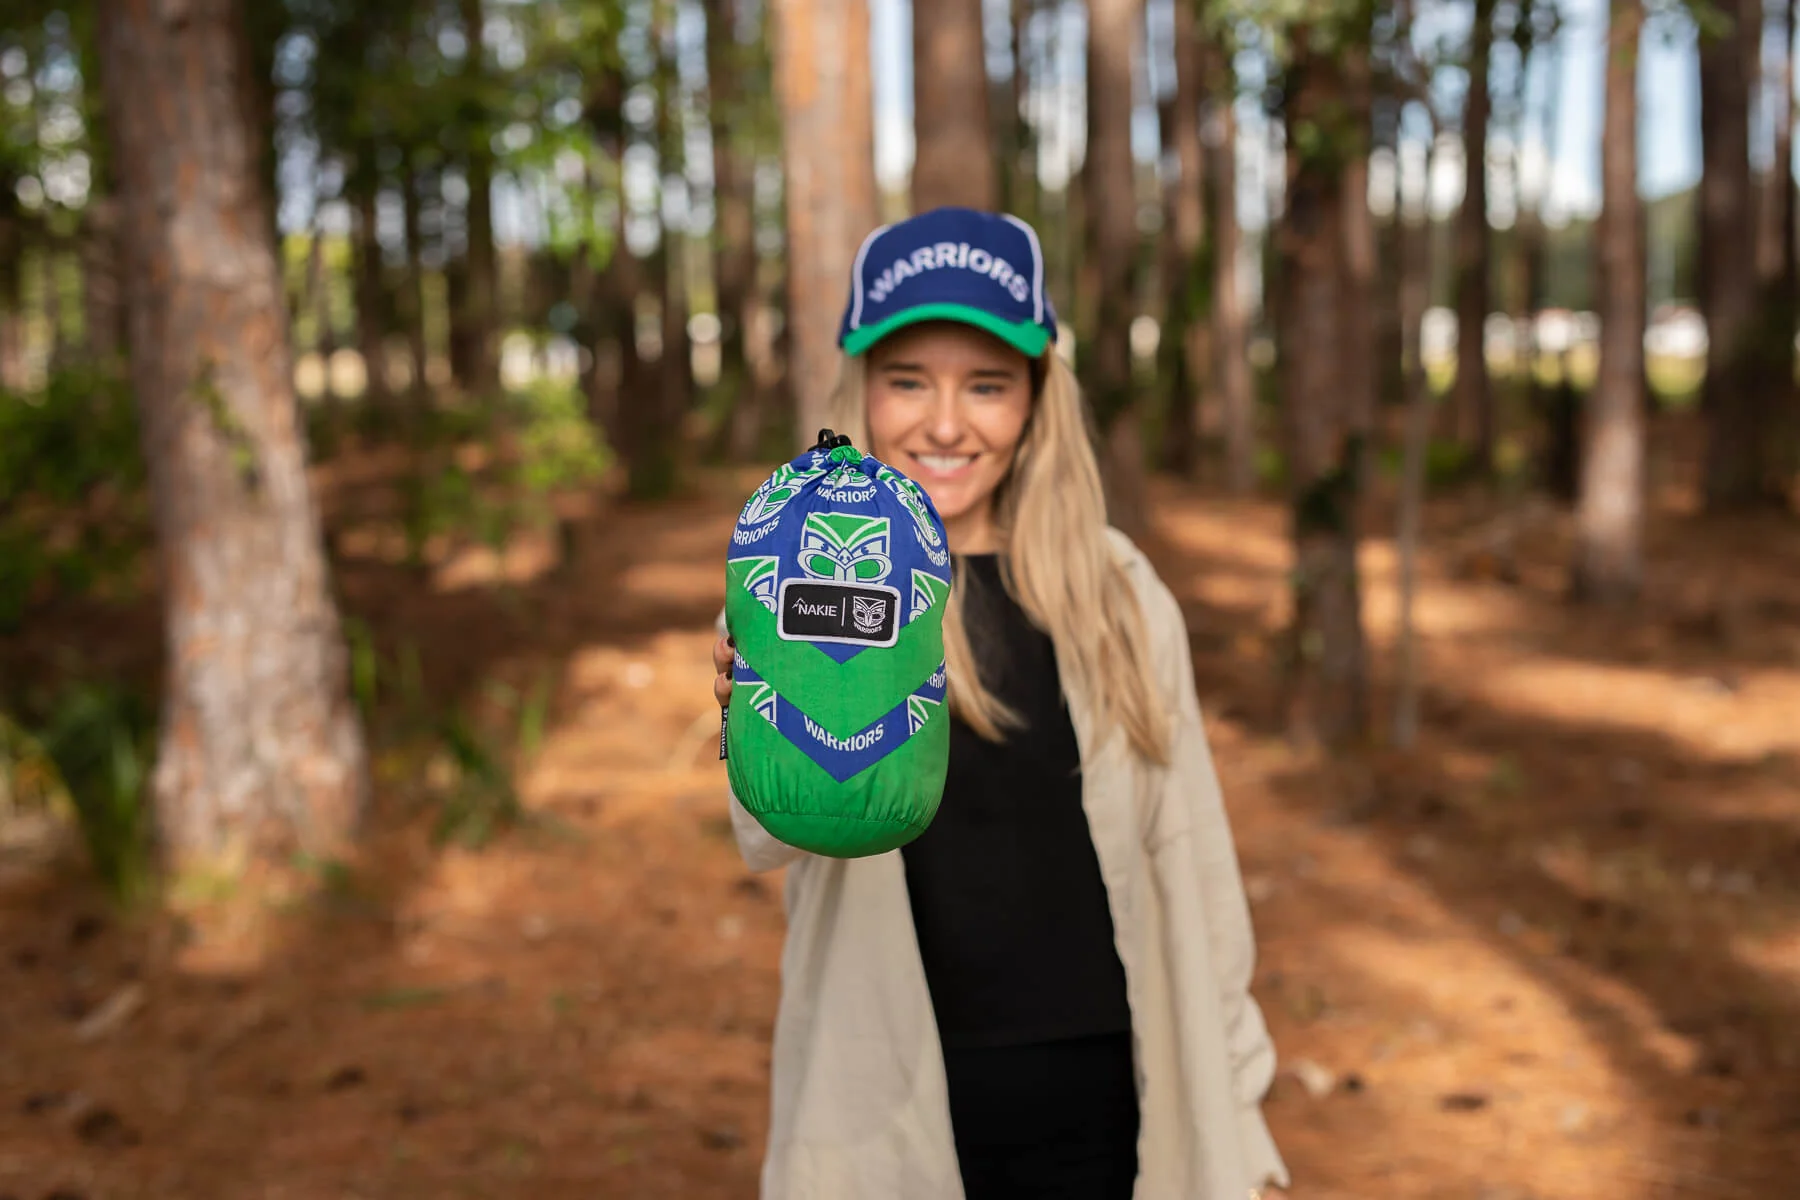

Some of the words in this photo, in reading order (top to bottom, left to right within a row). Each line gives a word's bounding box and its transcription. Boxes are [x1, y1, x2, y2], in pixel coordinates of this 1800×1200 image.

[868, 242, 1029, 303] WARRIORS
[798, 604, 838, 617] NAKIE
[853, 621, 882, 634] WARRIORS
[803, 714, 884, 751] WARRIORS
